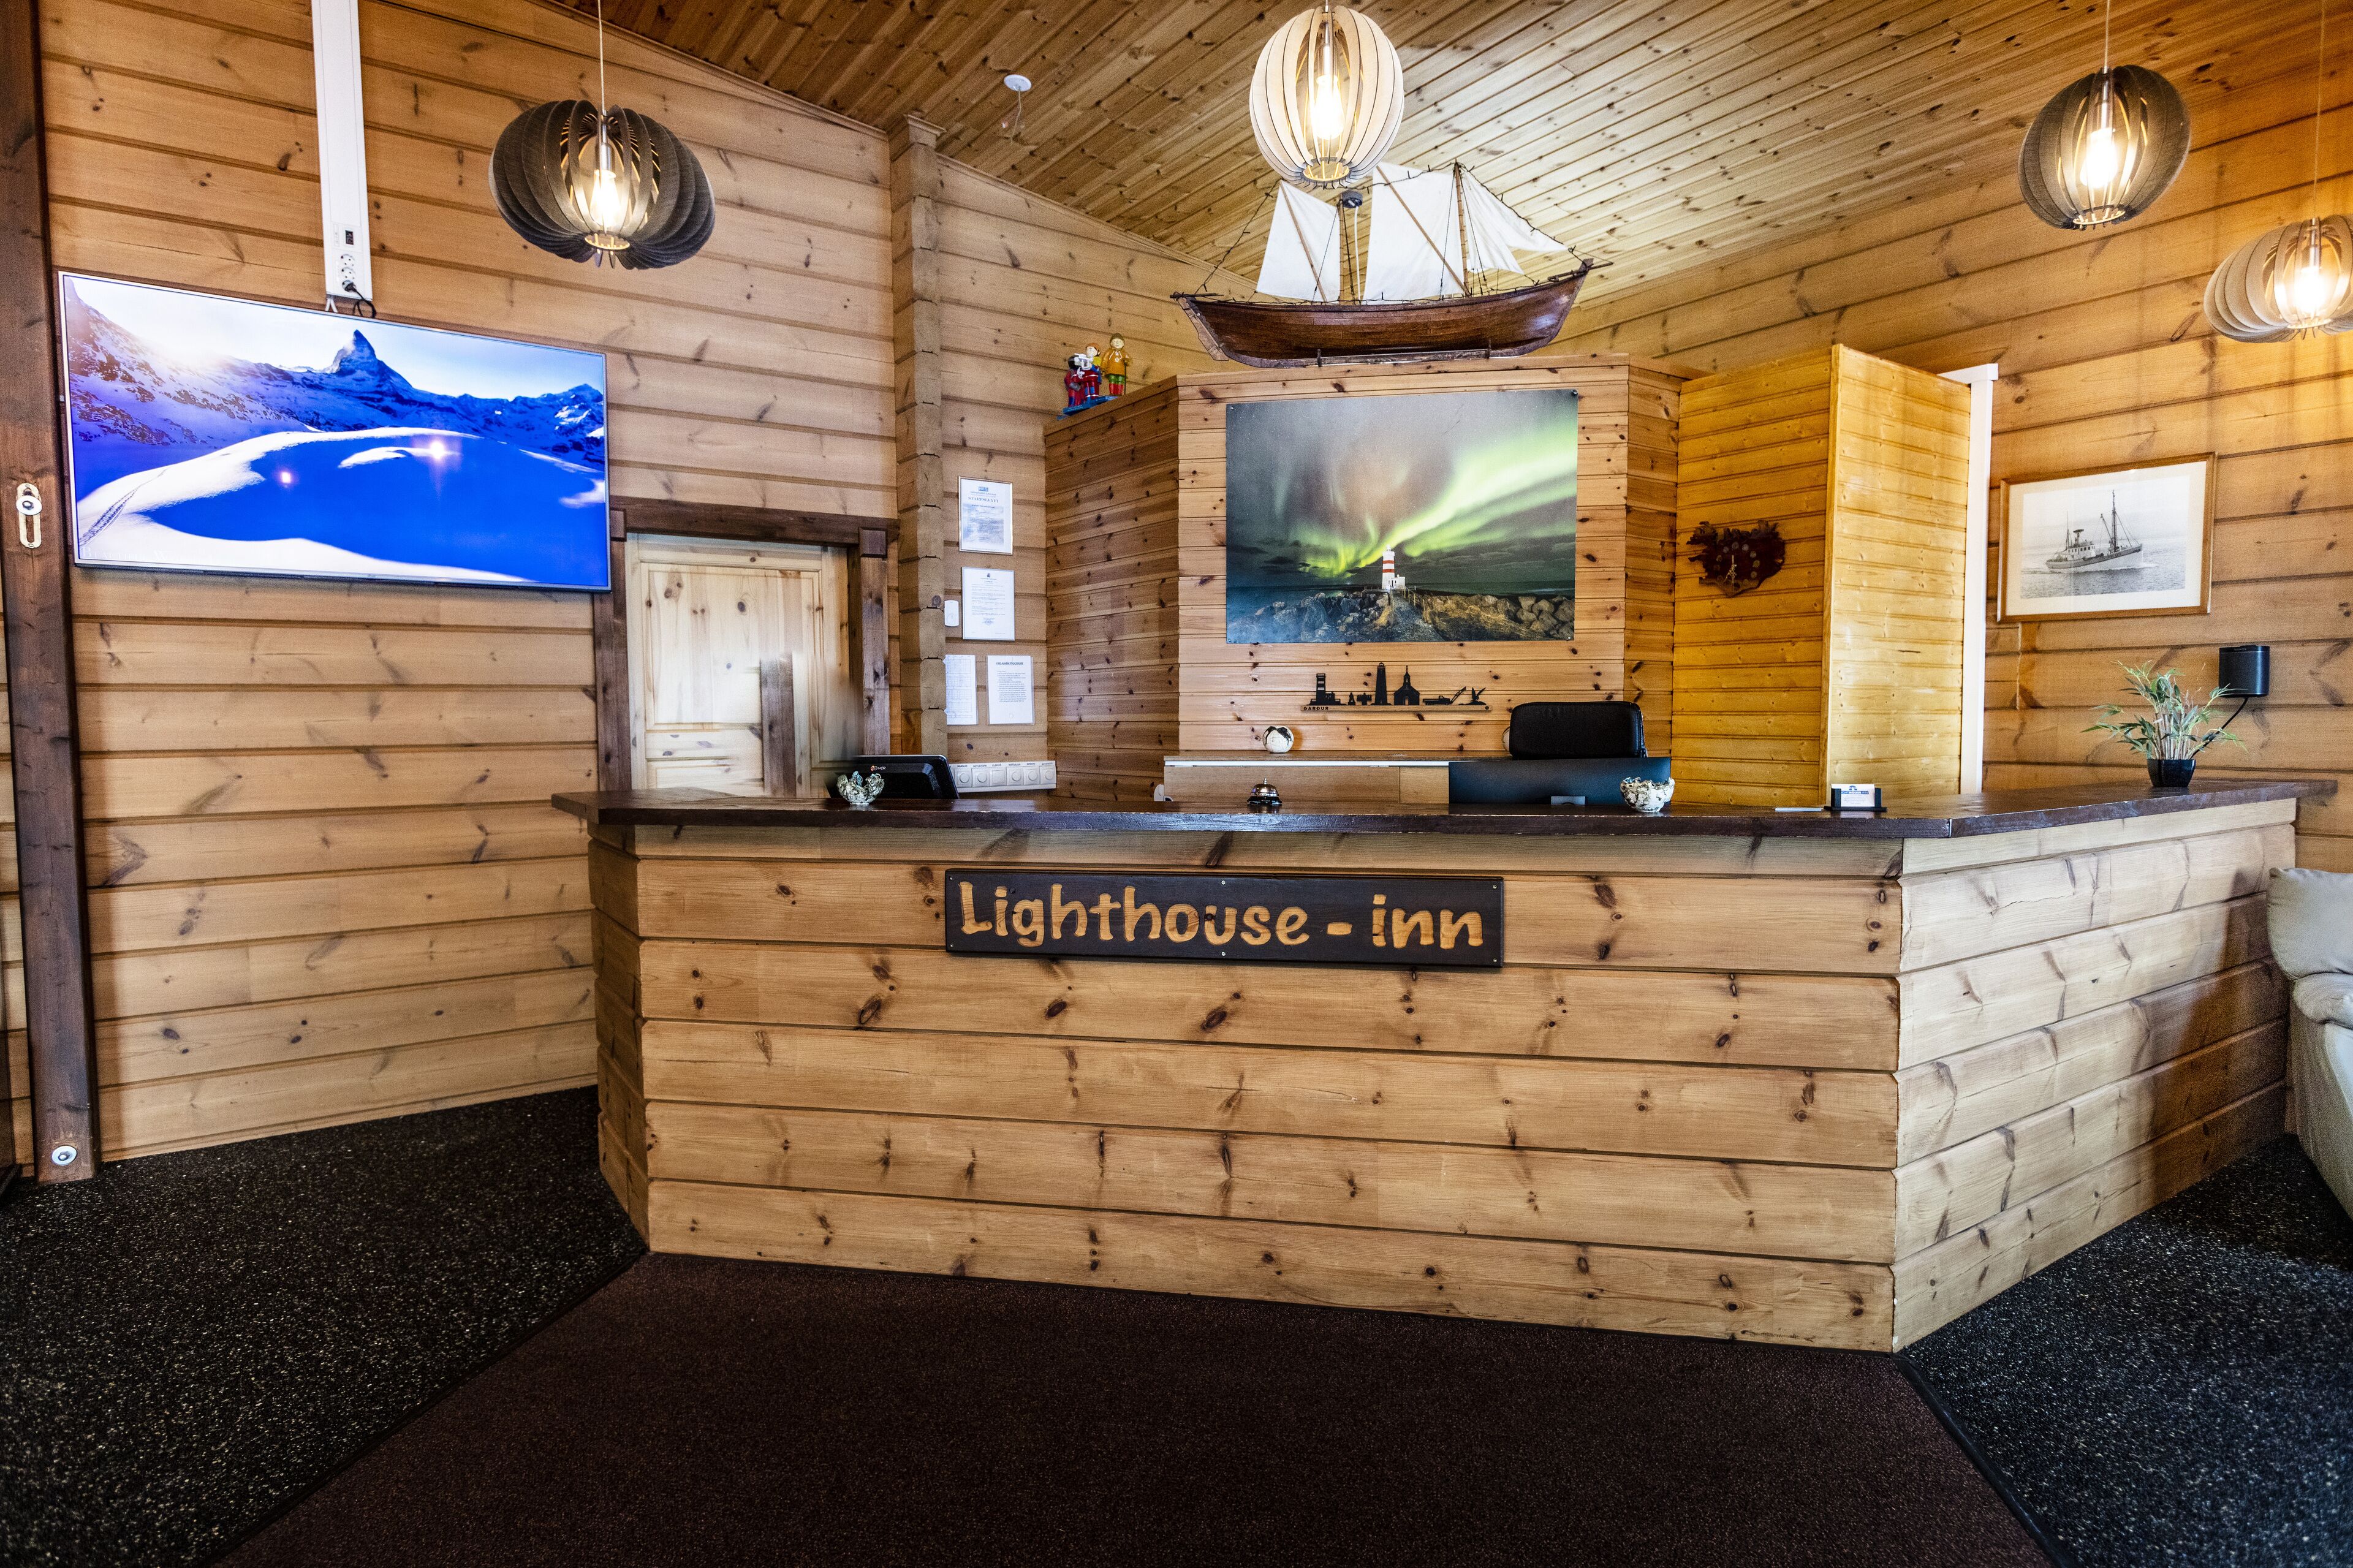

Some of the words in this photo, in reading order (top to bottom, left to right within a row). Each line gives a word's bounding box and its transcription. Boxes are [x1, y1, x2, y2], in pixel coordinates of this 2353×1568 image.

[958, 881, 1309, 947] Lighthouse
[1326, 922, 1353, 936] -
[1371, 893, 1483, 950] inn
